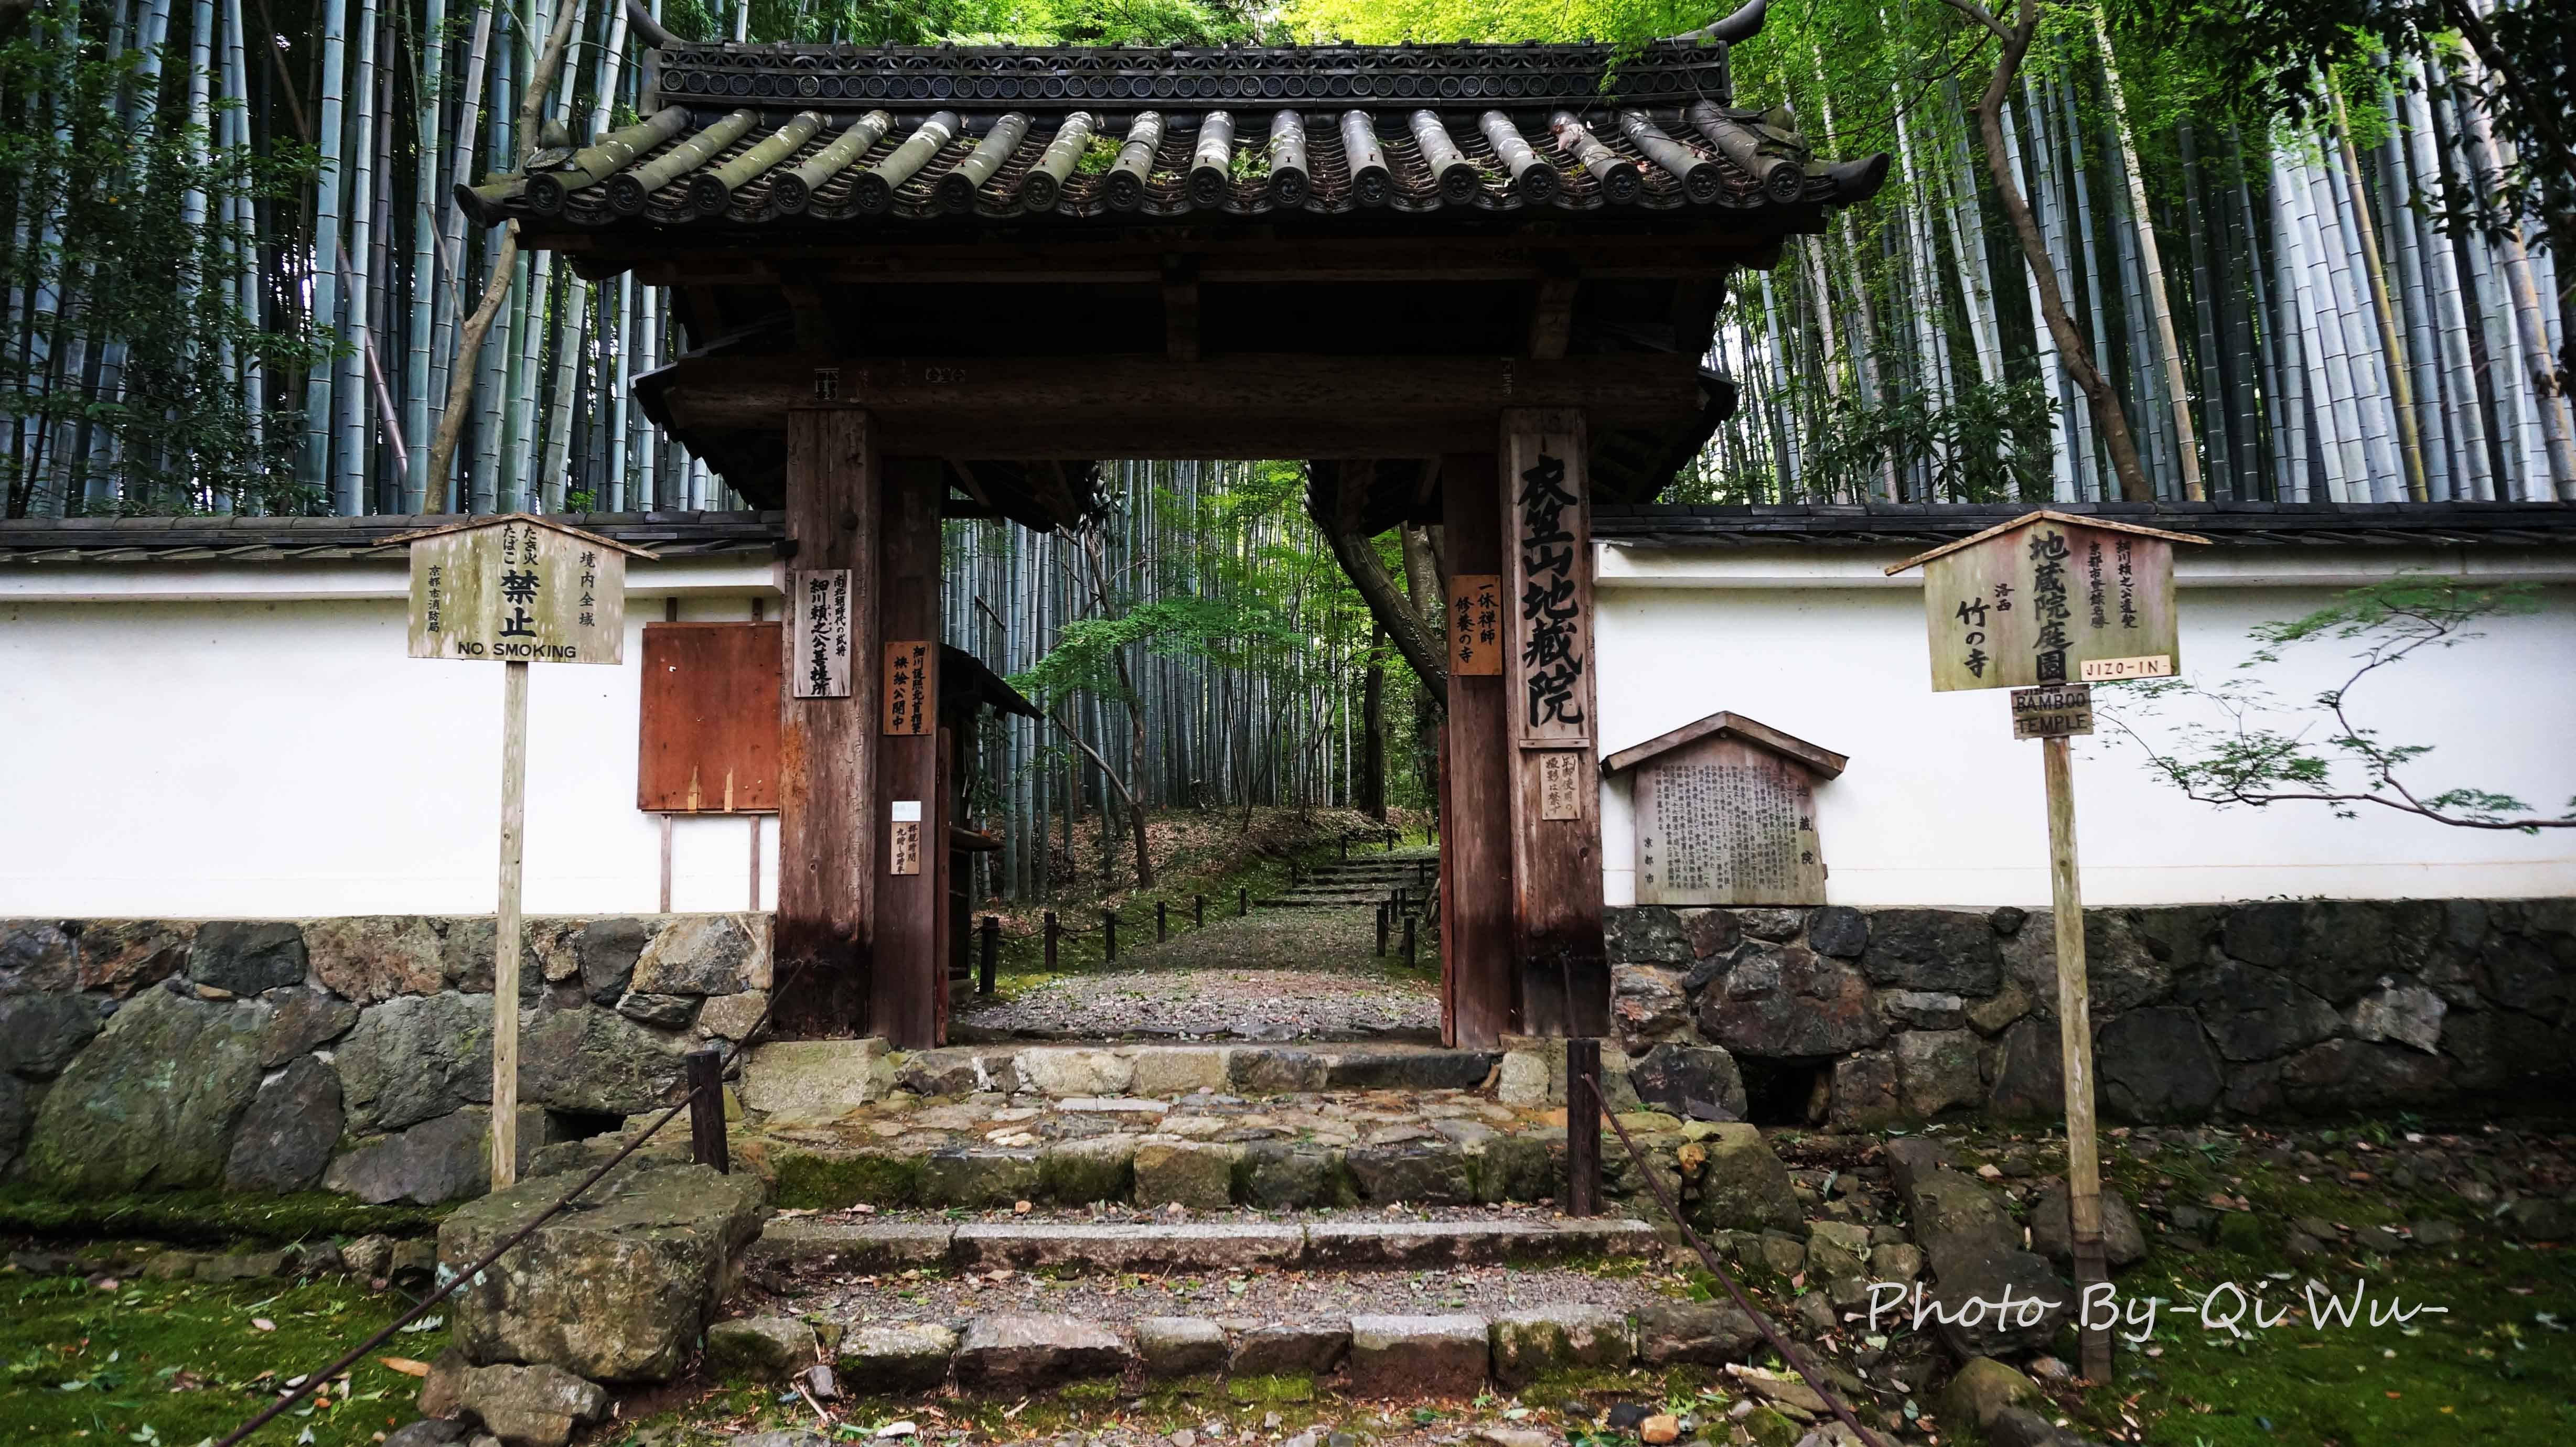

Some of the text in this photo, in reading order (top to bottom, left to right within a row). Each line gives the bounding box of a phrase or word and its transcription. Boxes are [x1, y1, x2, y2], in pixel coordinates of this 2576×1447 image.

[503, 525, 516, 564] たばこ
[427, 565, 441, 633] 京都市消防局
[499, 569, 541, 638] 禁止
[579, 552, 596, 627] 境内全域
[1477, 584, 1499, 646] 一休禅師
[1994, 584, 2015, 611] 洛西
[2030, 530, 2075, 681] 地蔵院庭園
[458, 642, 576, 658] NO SMOKING
[809, 578, 832, 696] 細川頼之公菩提所
[1455, 597, 1475, 663] 修養の寺
[1955, 597, 1991, 678] 竹の寺
[2016, 714, 2088, 733] TEMPLE
[2017, 693, 2086, 712] BAMBOO
[1644, 836, 1655, 886] 京都市
